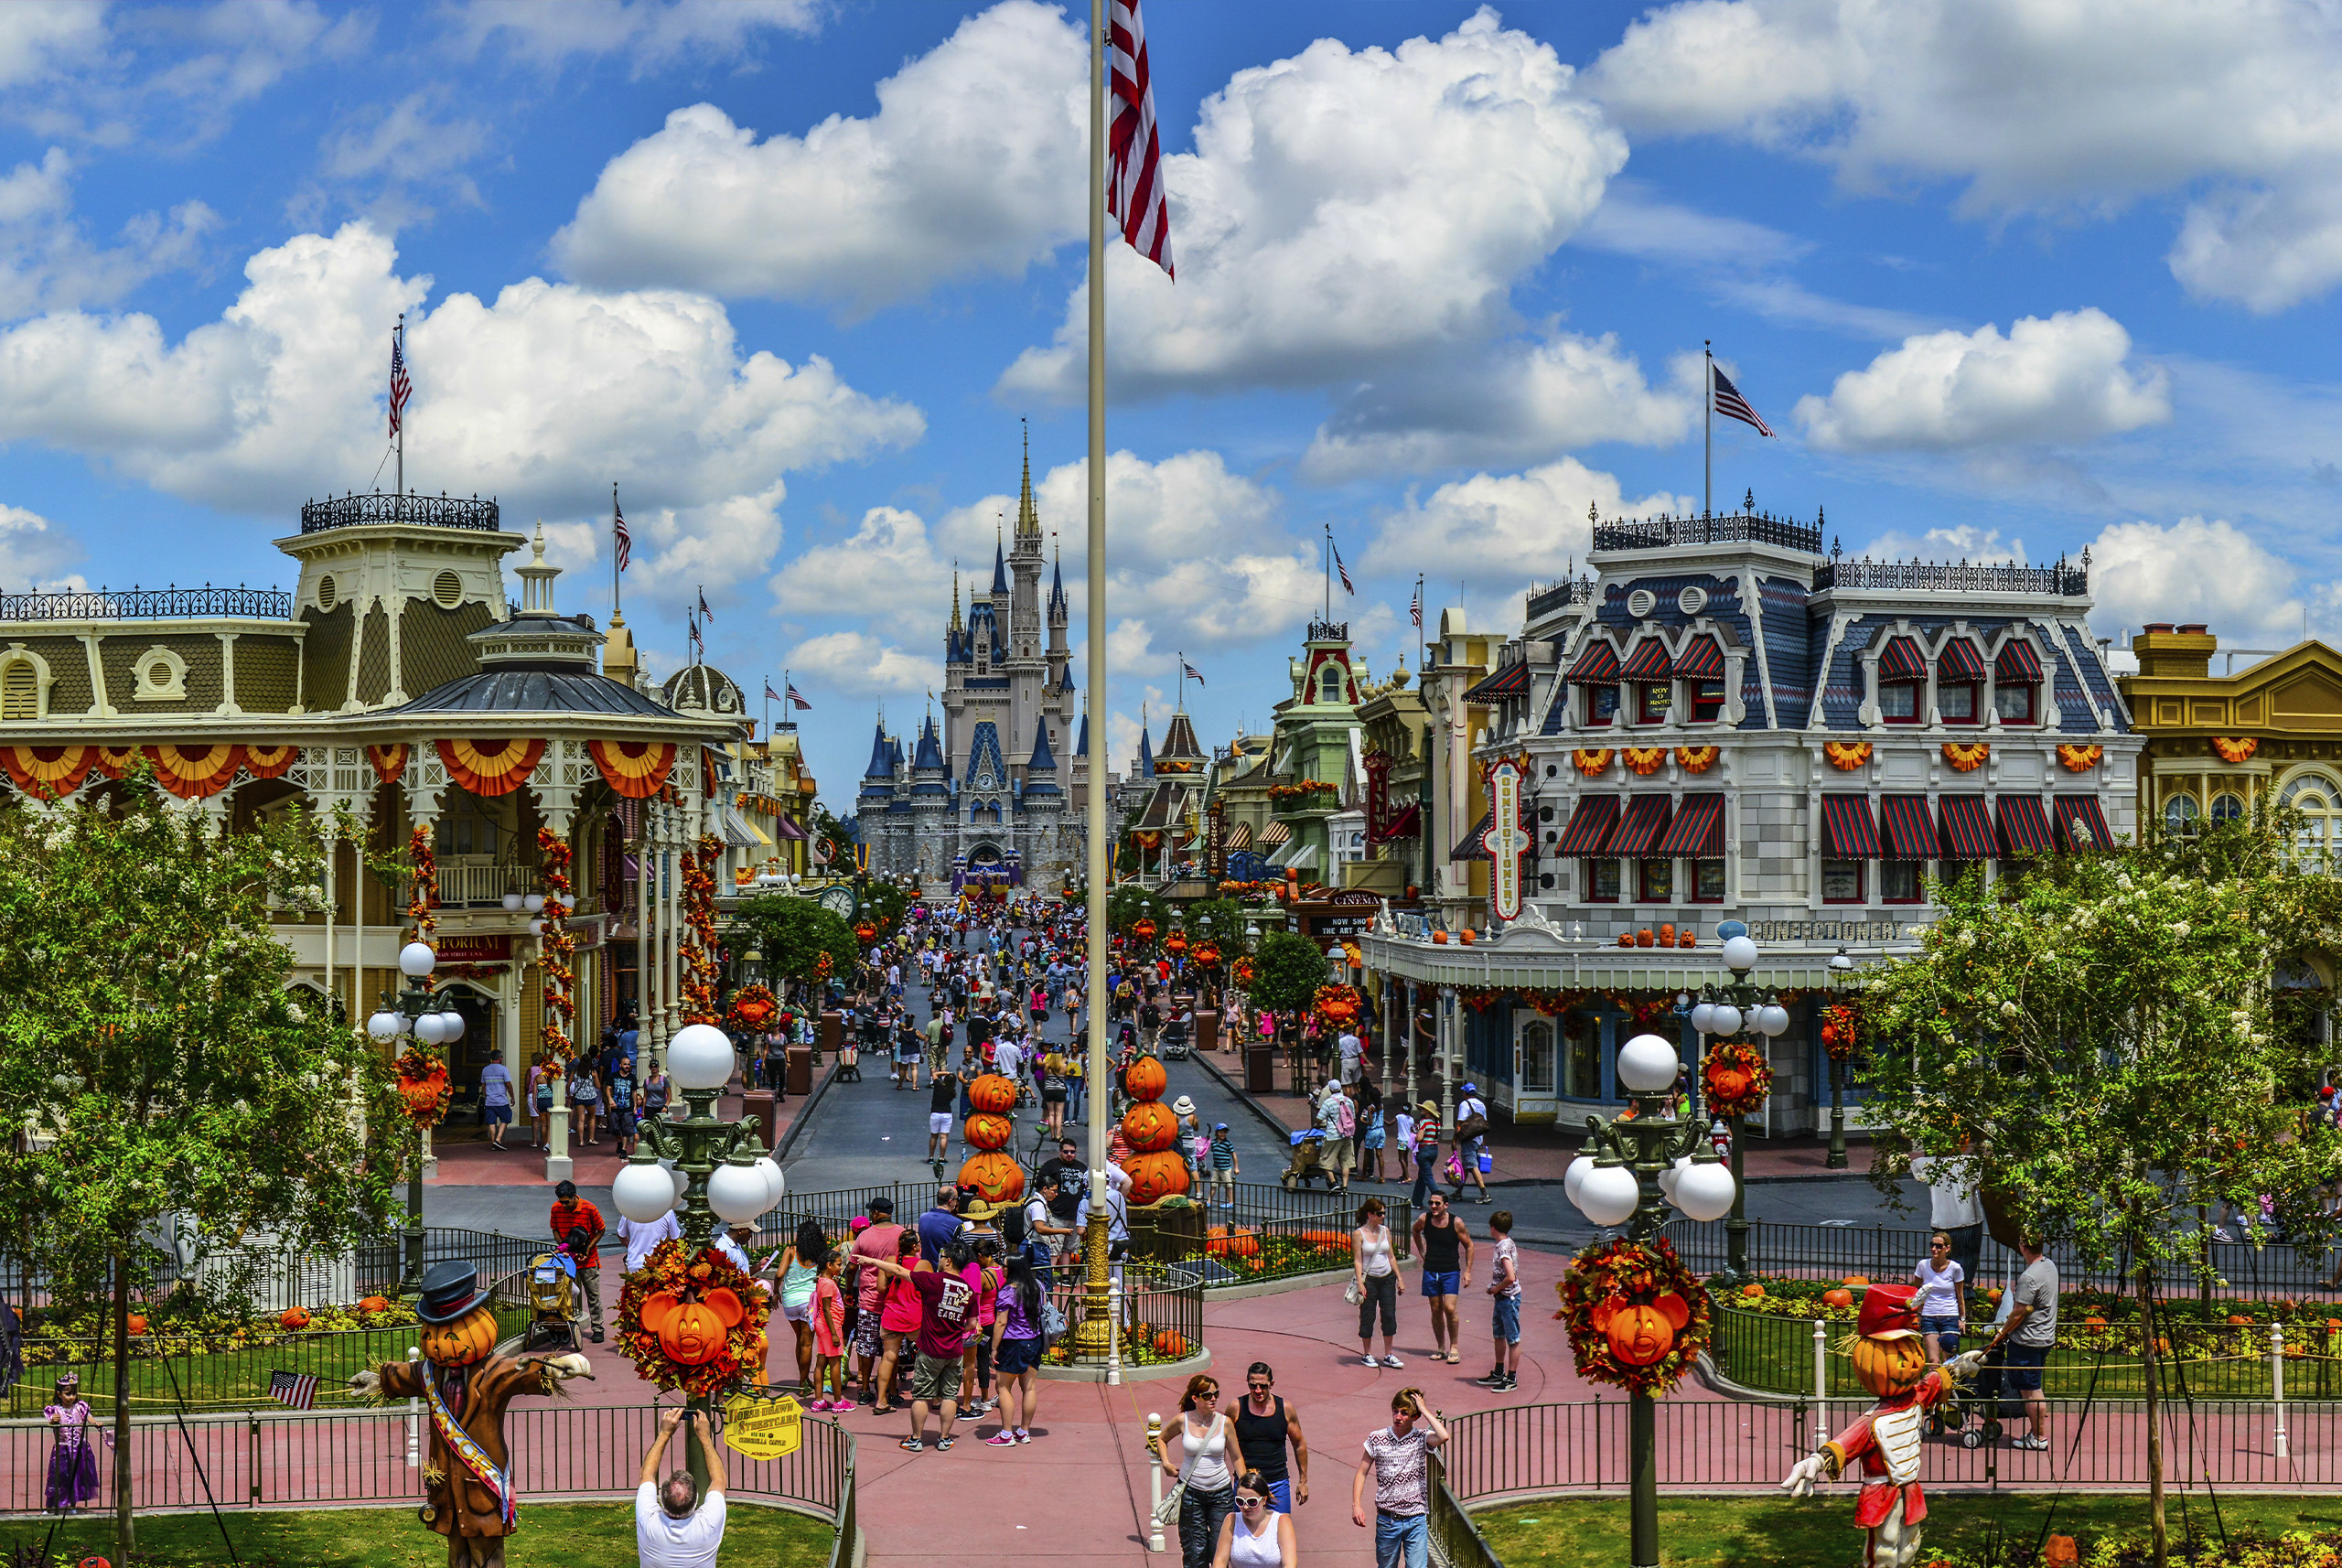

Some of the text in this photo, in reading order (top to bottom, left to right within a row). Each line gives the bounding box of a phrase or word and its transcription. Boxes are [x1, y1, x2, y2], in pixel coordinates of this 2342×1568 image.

[1501, 777, 1512, 909] CONFECTIONERY
[609, 824, 619, 902] EMPORIUM
[1334, 896, 1380, 906] CINEMA
[1750, 920, 1905, 942] CONFECTIONERY
[437, 937, 499, 950] PORIUM
[938, 1309, 962, 1322] EAGLE
[425, 1381, 493, 1478] MAYOR
[738, 1414, 799, 1435] STREETCARS
